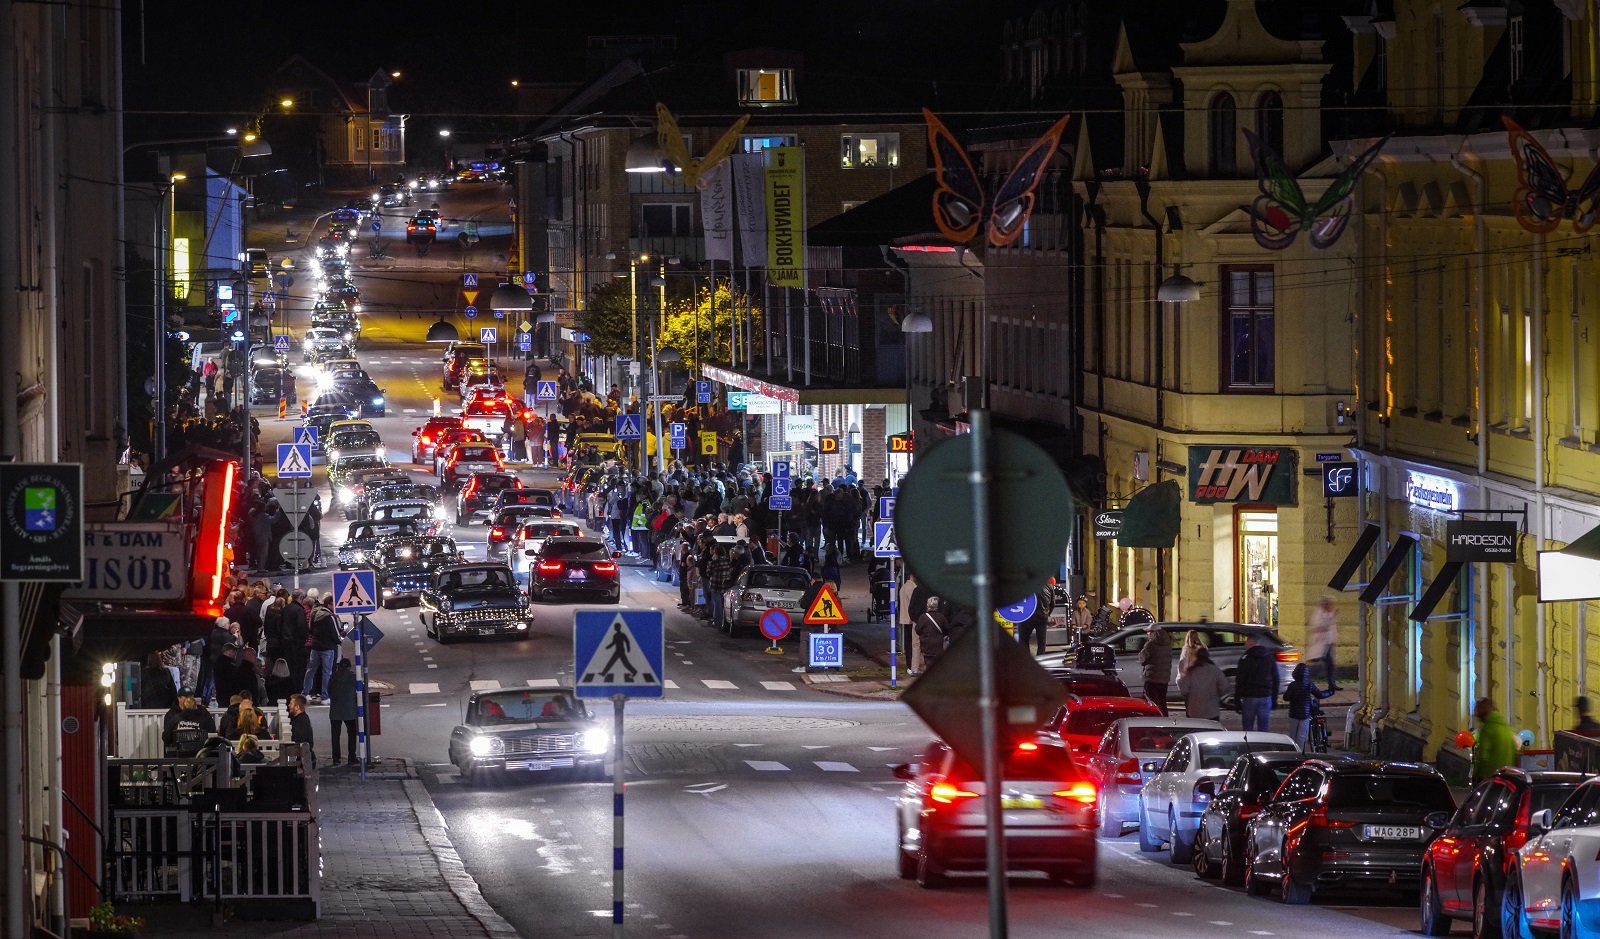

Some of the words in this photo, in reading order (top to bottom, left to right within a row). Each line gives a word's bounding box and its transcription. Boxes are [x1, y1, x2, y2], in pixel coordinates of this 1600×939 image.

[701, 382, 708, 392] P
[674, 424, 683, 436] P
[1242, 449, 1281, 464] DAM
[776, 462, 788, 477] P
[103, 535, 113, 547] &
[119, 533, 163, 547] DAM
[818, 645, 834, 655] 30
[1373, 827, 1393, 837] WAG
[1396, 827, 1415, 837] 28P
